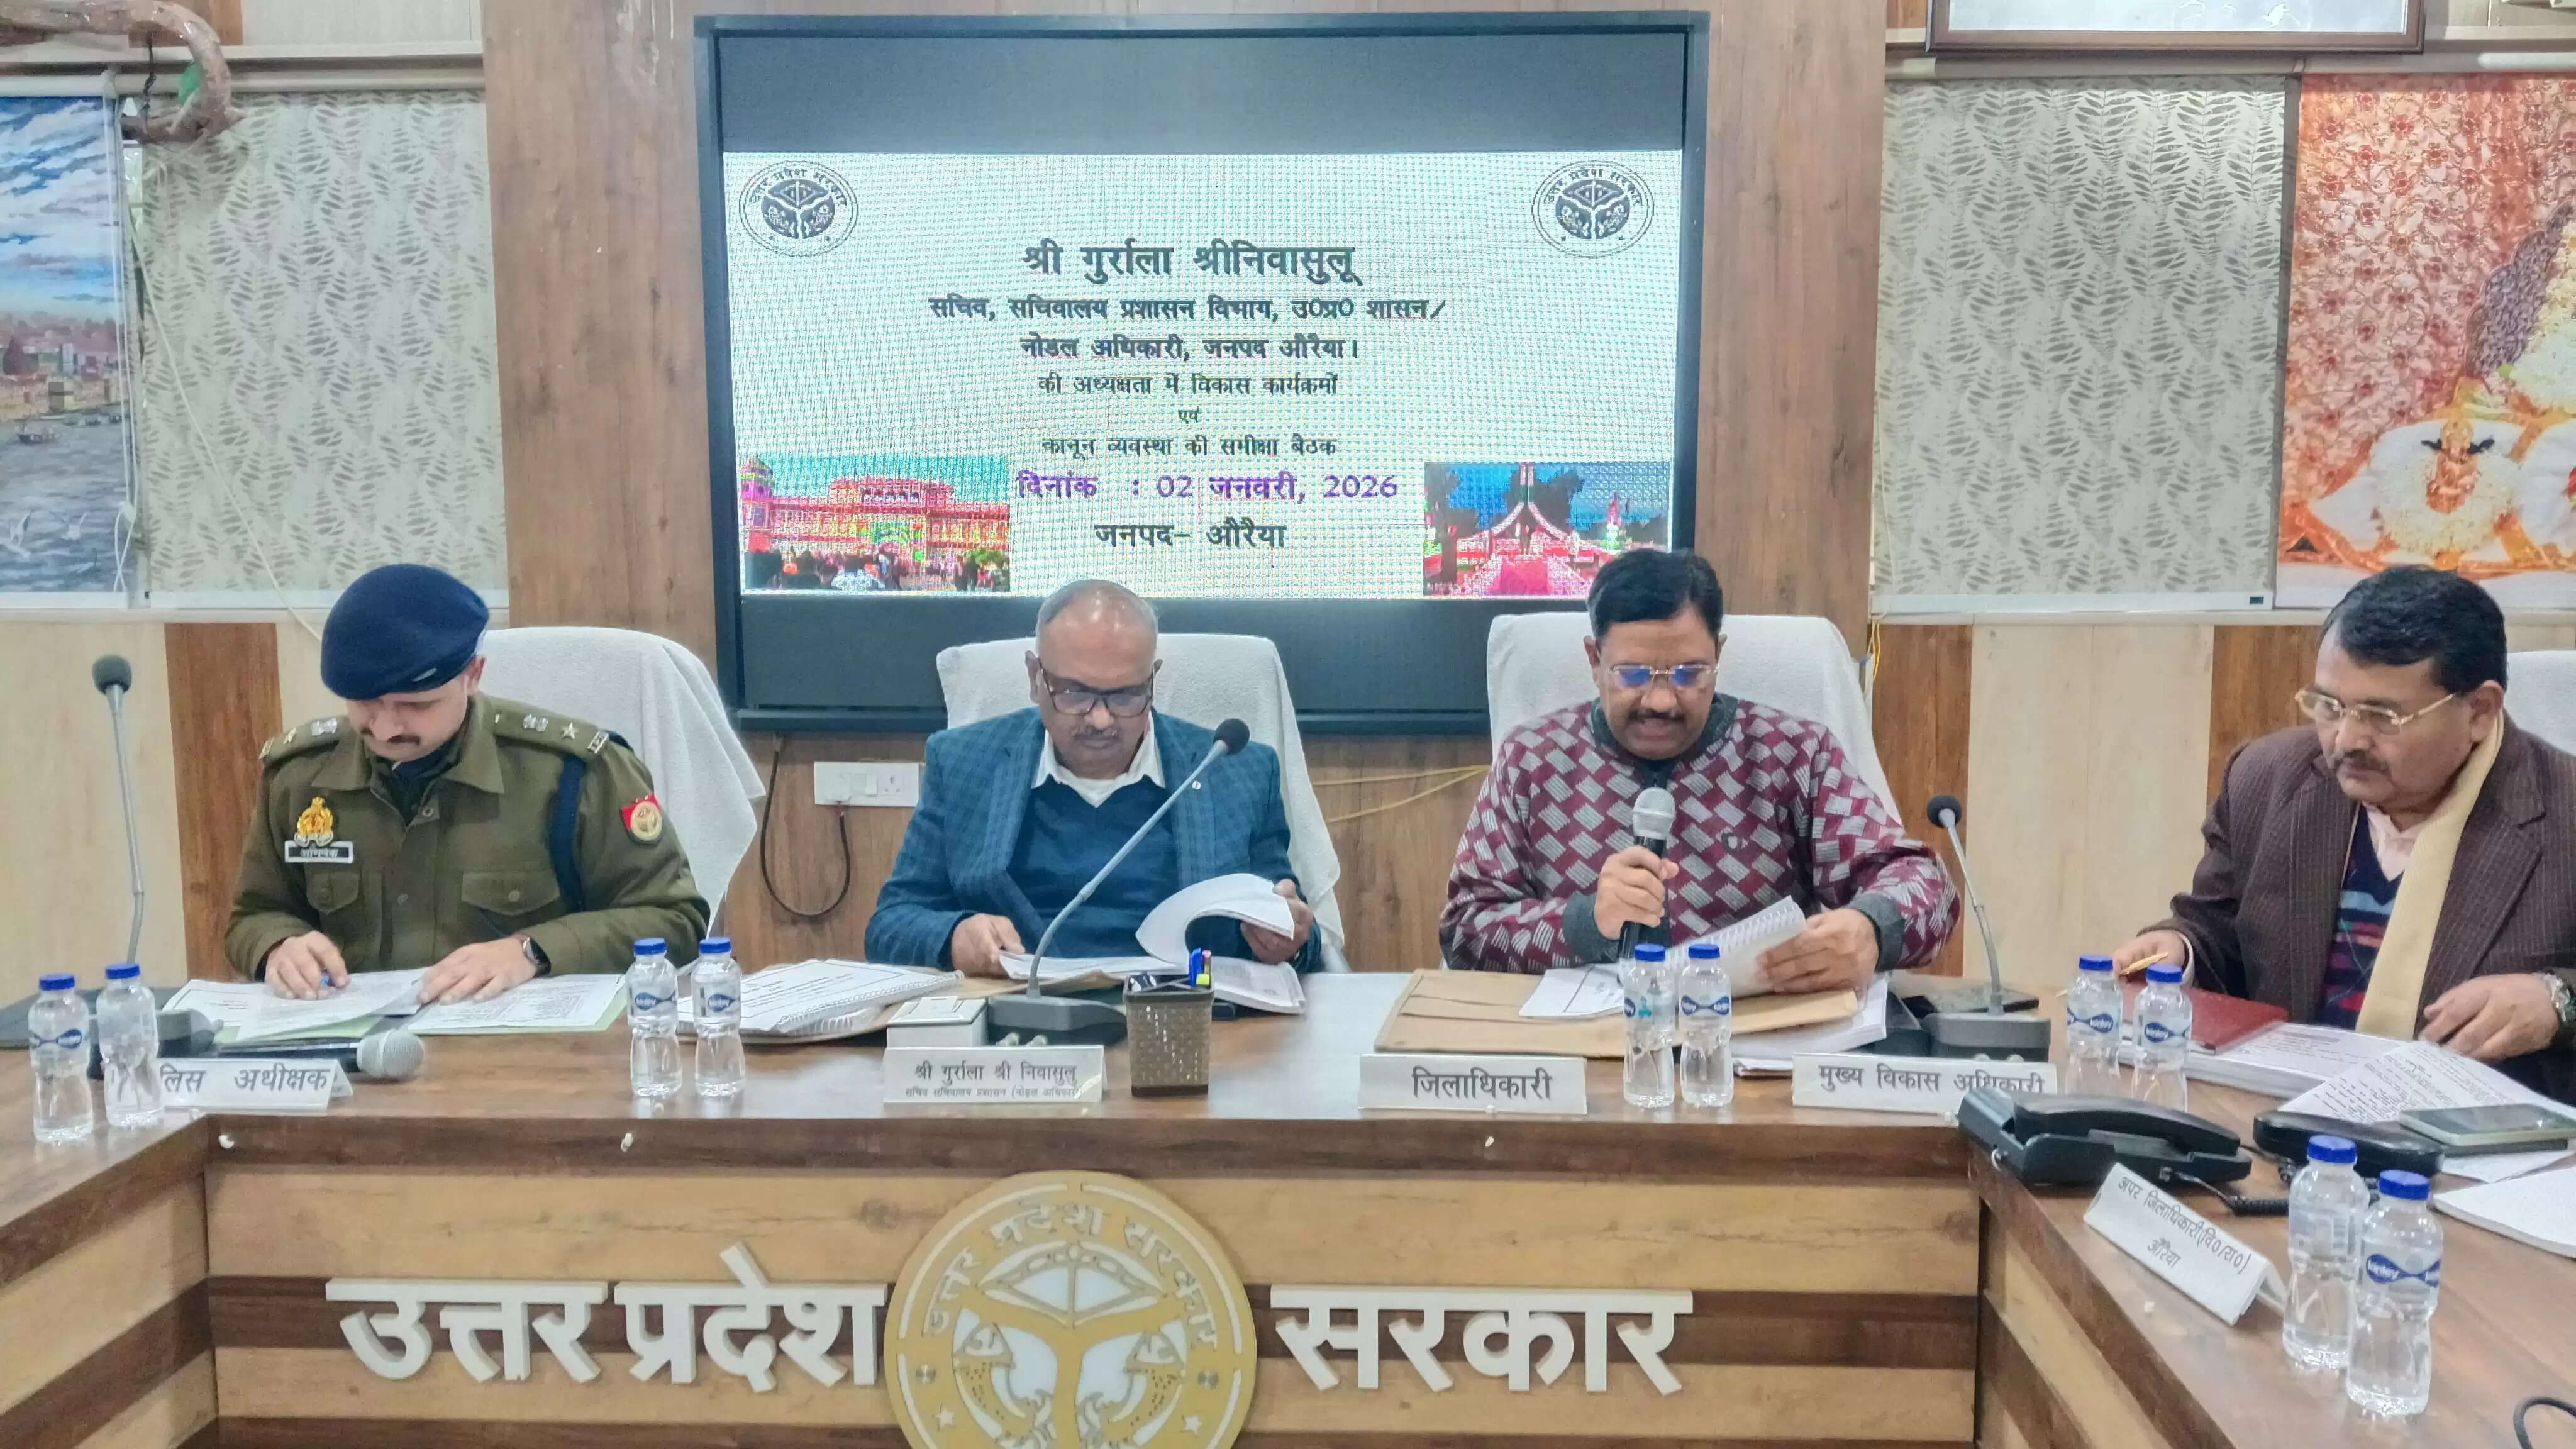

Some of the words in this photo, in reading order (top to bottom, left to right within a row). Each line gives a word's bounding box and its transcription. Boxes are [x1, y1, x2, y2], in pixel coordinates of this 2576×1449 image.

[1023, 238, 1063, 275] श्री
[1080, 238, 1174, 284] गुर्राला
[1193, 238, 1363, 286] श्रीनिवासुलू
[928, 292, 996, 321] सचिव,
[1008, 293, 1108, 319] सचिवालय
[1119, 299, 1196, 319] प्रशासन
[1207, 294, 1279, 322] विभाग,
[1020, 331, 1079, 358] नोडल
[1091, 334, 1190, 362] अधिकारी,
[1202, 339, 1269, 358] जनपद
[1038, 372, 1063, 394] की
[1073, 376, 1153, 394] अध्यक्षता
[1164, 371, 1179, 394] में
[1192, 372, 1252, 395] विकास
[1178, 406, 1200, 423] एवं
[1043, 438, 1095, 461] कानून
[1107, 438, 1174, 456] व्यवस्था
[1184, 433, 1208, 457] की
[1221, 434, 1279, 457] समीक्षा
[1291, 433, 1338, 457] बैठक
[1016, 469, 1098, 499] दिनांक
[1156, 476, 1194, 498] 02
[1209, 470, 1306, 504] जनवरी,
[1323, 475, 1397, 498] 2026
[1206, 516, 1287, 548] औरैया
[233, 1062, 331, 1092] अधीक्षक
[914, 1060, 933, 1081] श्री
[941, 1060, 985, 1085] गुर्राला
[994, 1060, 1013, 1081] श्री
[1021, 1060, 1077, 1085] निवासुलु
[1413, 1066, 1553, 1100] जिलाधिकारी
[1818, 1064, 1864, 1092] मुख्य
[1875, 1063, 1941, 1091] विकास
[2118, 1176, 2143, 1199] अपर
[2147, 1236, 2182, 1269] औरैया
[325, 1277, 609, 1384] उत्तर
[613, 1241, 889, 1393] प्रदेश
[1270, 1284, 1693, 1396] सरकार
